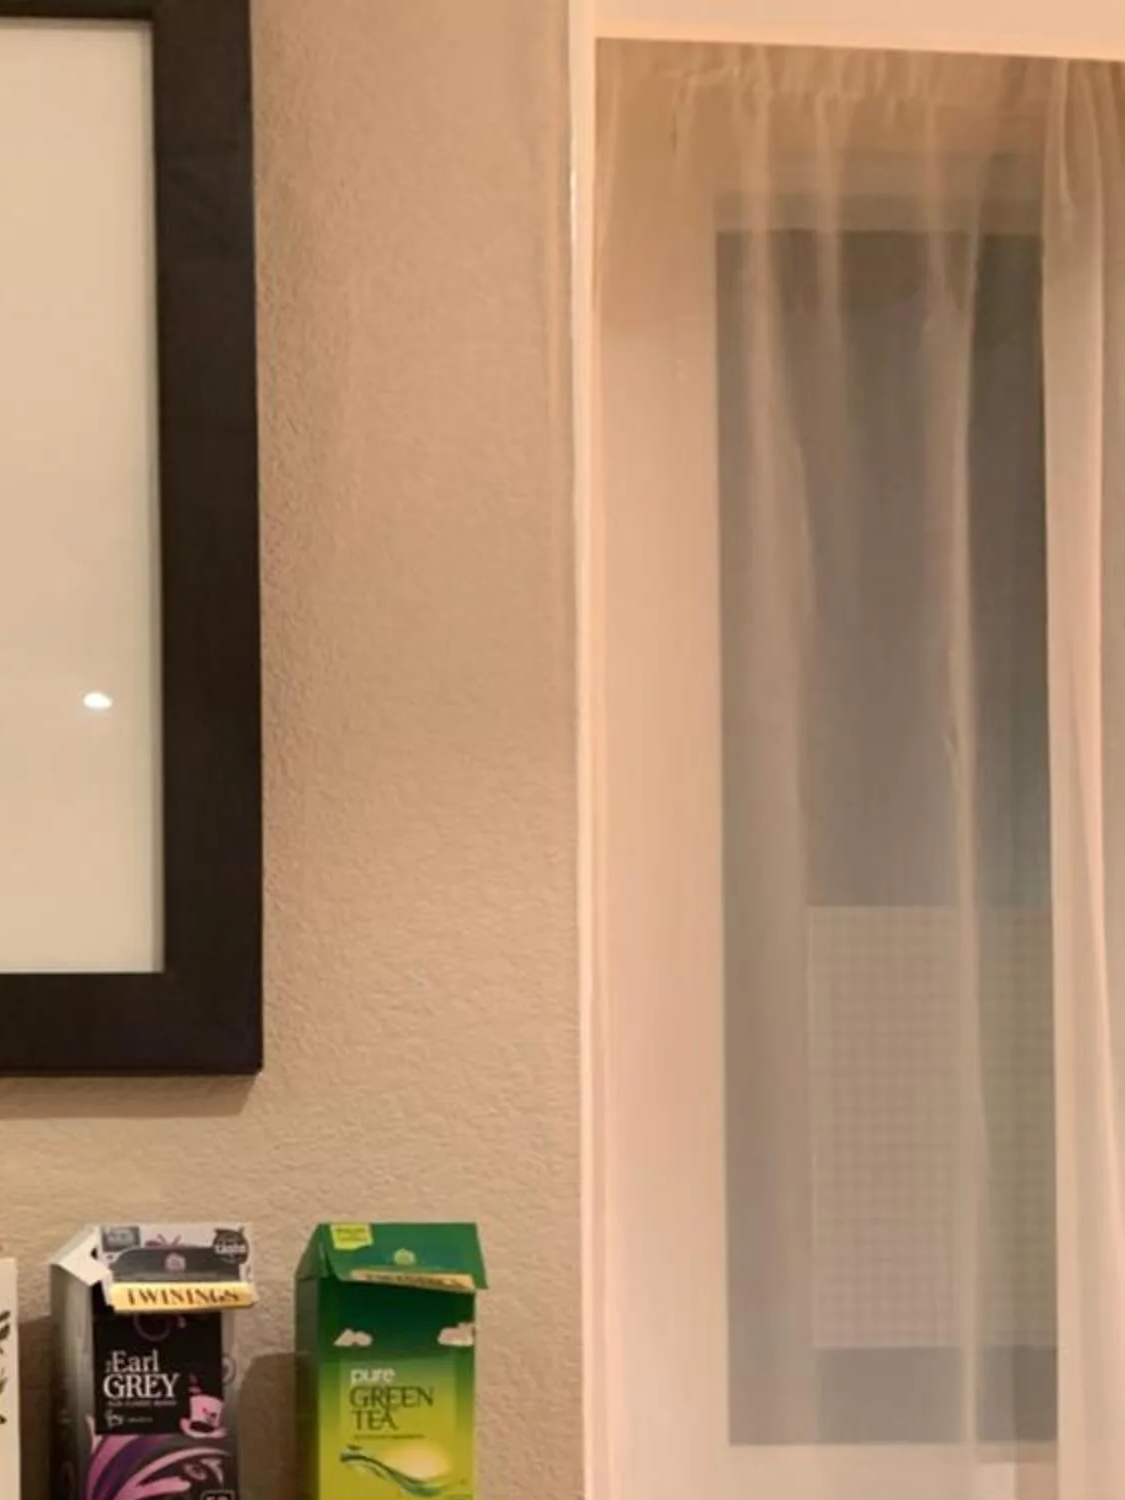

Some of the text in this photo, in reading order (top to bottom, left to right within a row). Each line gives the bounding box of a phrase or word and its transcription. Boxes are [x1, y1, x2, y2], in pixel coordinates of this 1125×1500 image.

[127, 1288, 239, 1306] TWININGS
[111, 1349, 160, 1373] Earl
[103, 1372, 179, 1399] GREY
[350, 1368, 396, 1384] pure
[349, 1385, 434, 1408] GREEN
[351, 1409, 399, 1431] TEA
